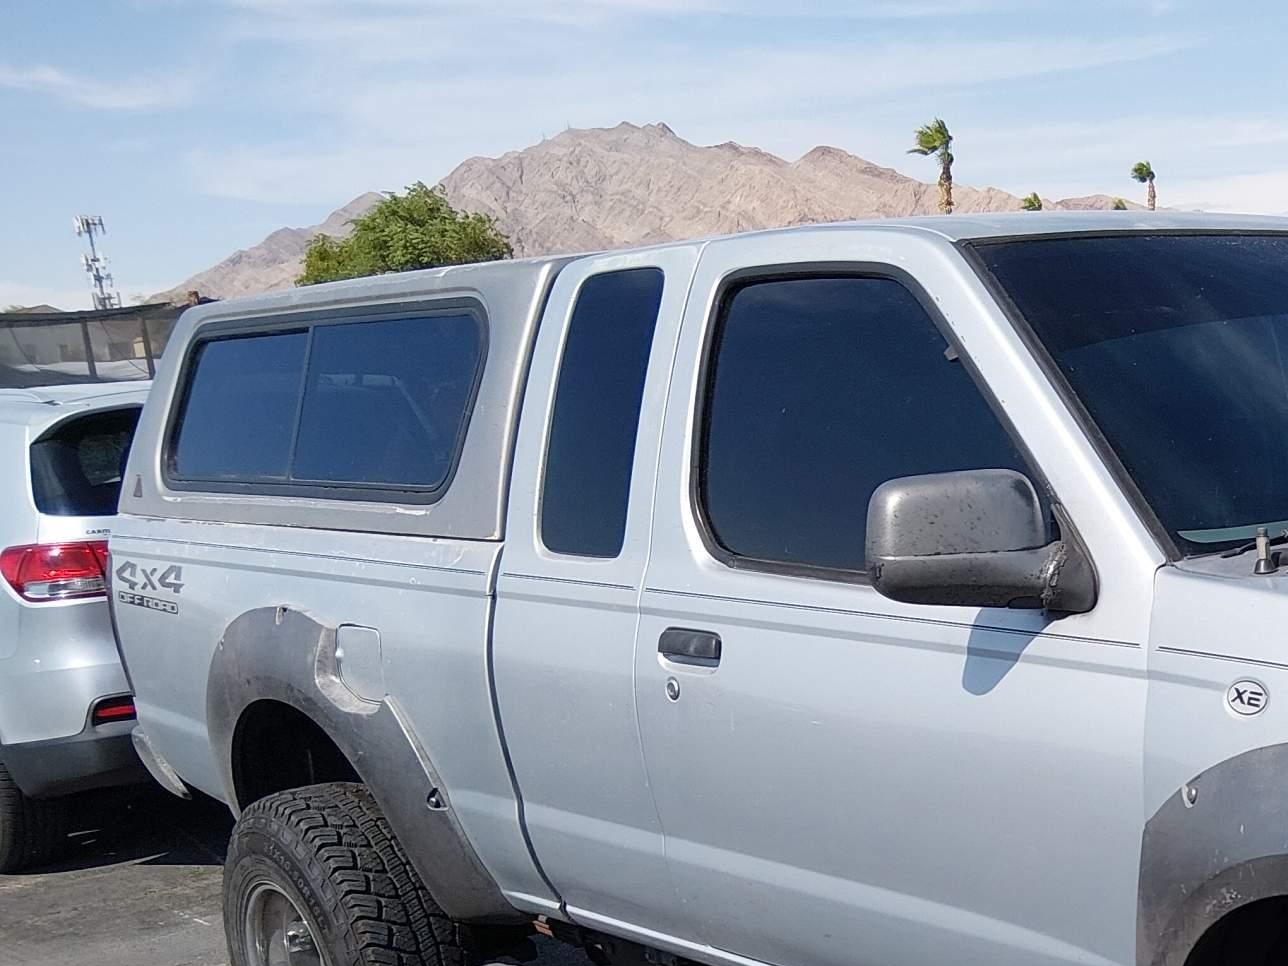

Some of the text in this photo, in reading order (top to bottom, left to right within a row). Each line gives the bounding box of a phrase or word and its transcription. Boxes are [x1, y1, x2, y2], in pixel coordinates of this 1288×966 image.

[119, 592, 178, 613] OFF ROAD
[1231, 687, 1263, 708] XE
